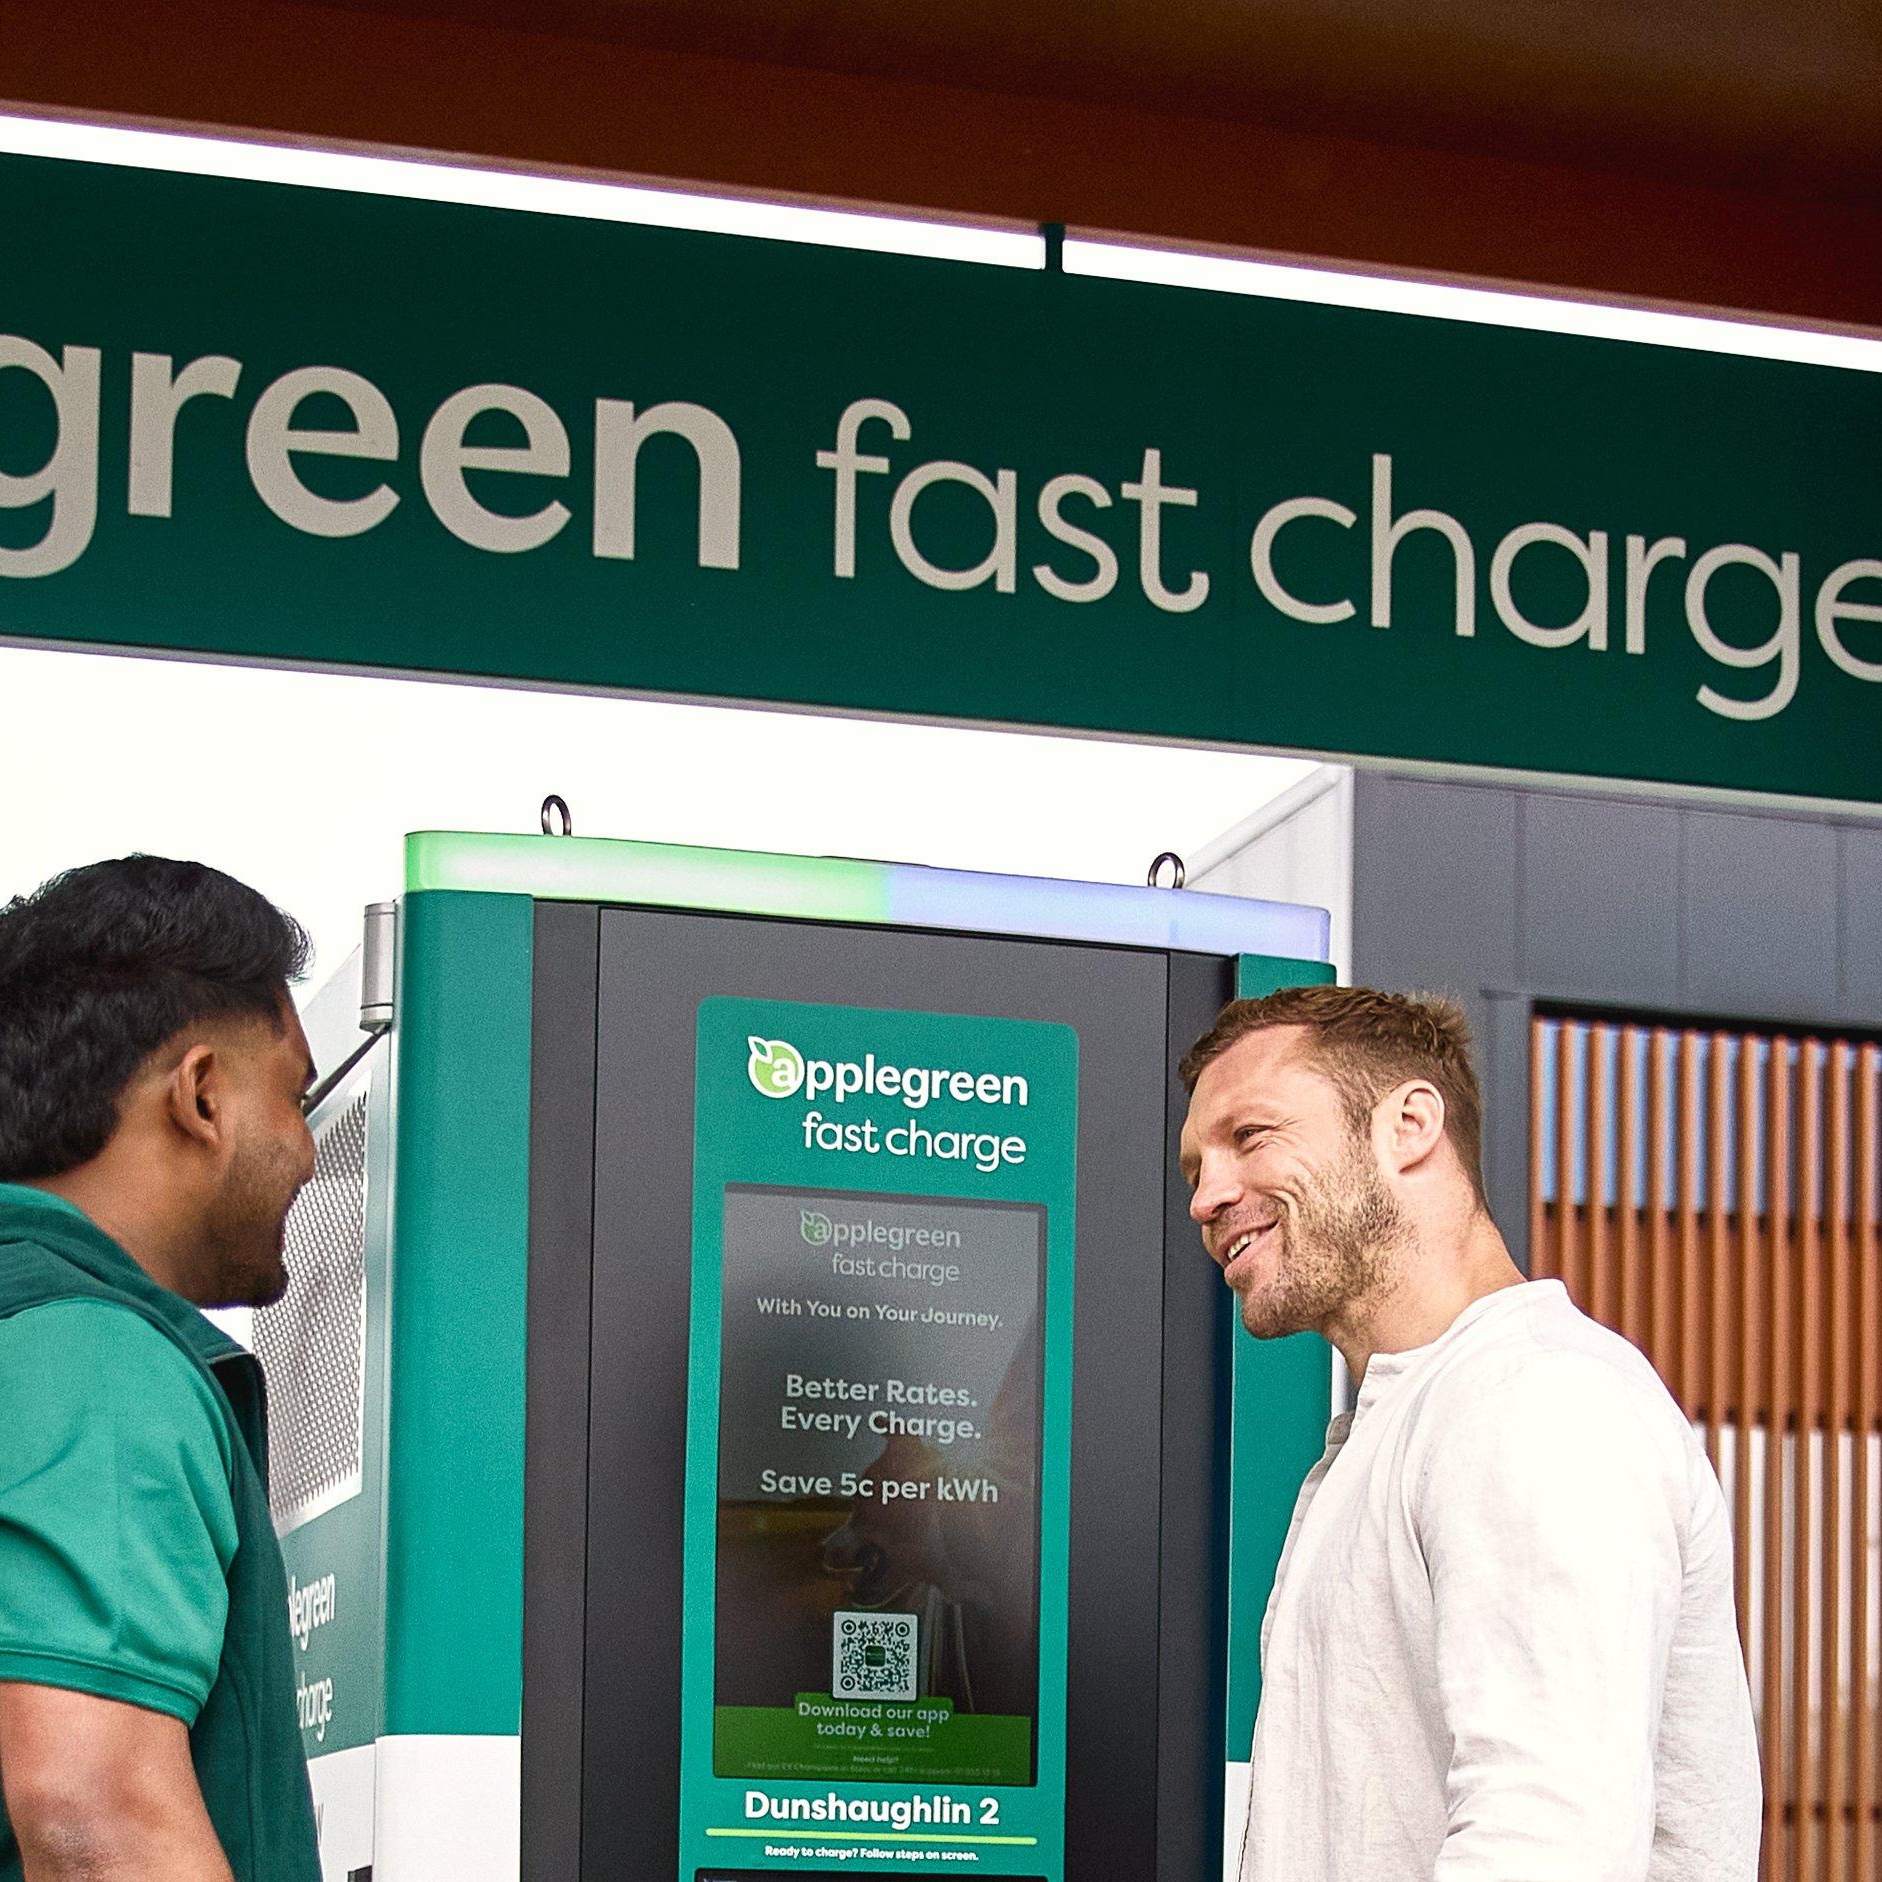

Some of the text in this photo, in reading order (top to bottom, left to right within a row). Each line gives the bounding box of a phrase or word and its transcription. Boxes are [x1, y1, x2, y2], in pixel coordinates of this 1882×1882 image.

[816, 398, 1210, 613] fast
[748, 1036, 1028, 1109] applegreen
[802, 1111, 1027, 1173] fast charge
[800, 1209, 961, 1251] applegreen
[832, 1253, 960, 1287] fast charge
[757, 1298, 1004, 1331] With You on Your Journey.
[786, 1374, 978, 1408] Better Rates.
[781, 1405, 982, 1445] Every Charge.
[760, 1469, 999, 1506] Save 5c per kWh
[288, 1573, 335, 1652] legreen
[798, 1702, 950, 1725] Download our app
[817, 1722, 931, 1740] today & save!
[744, 1790, 1000, 1831] Dunshaughlin 2
[765, 1845, 979, 1862] Ready to charge? Follow steps on screen.
